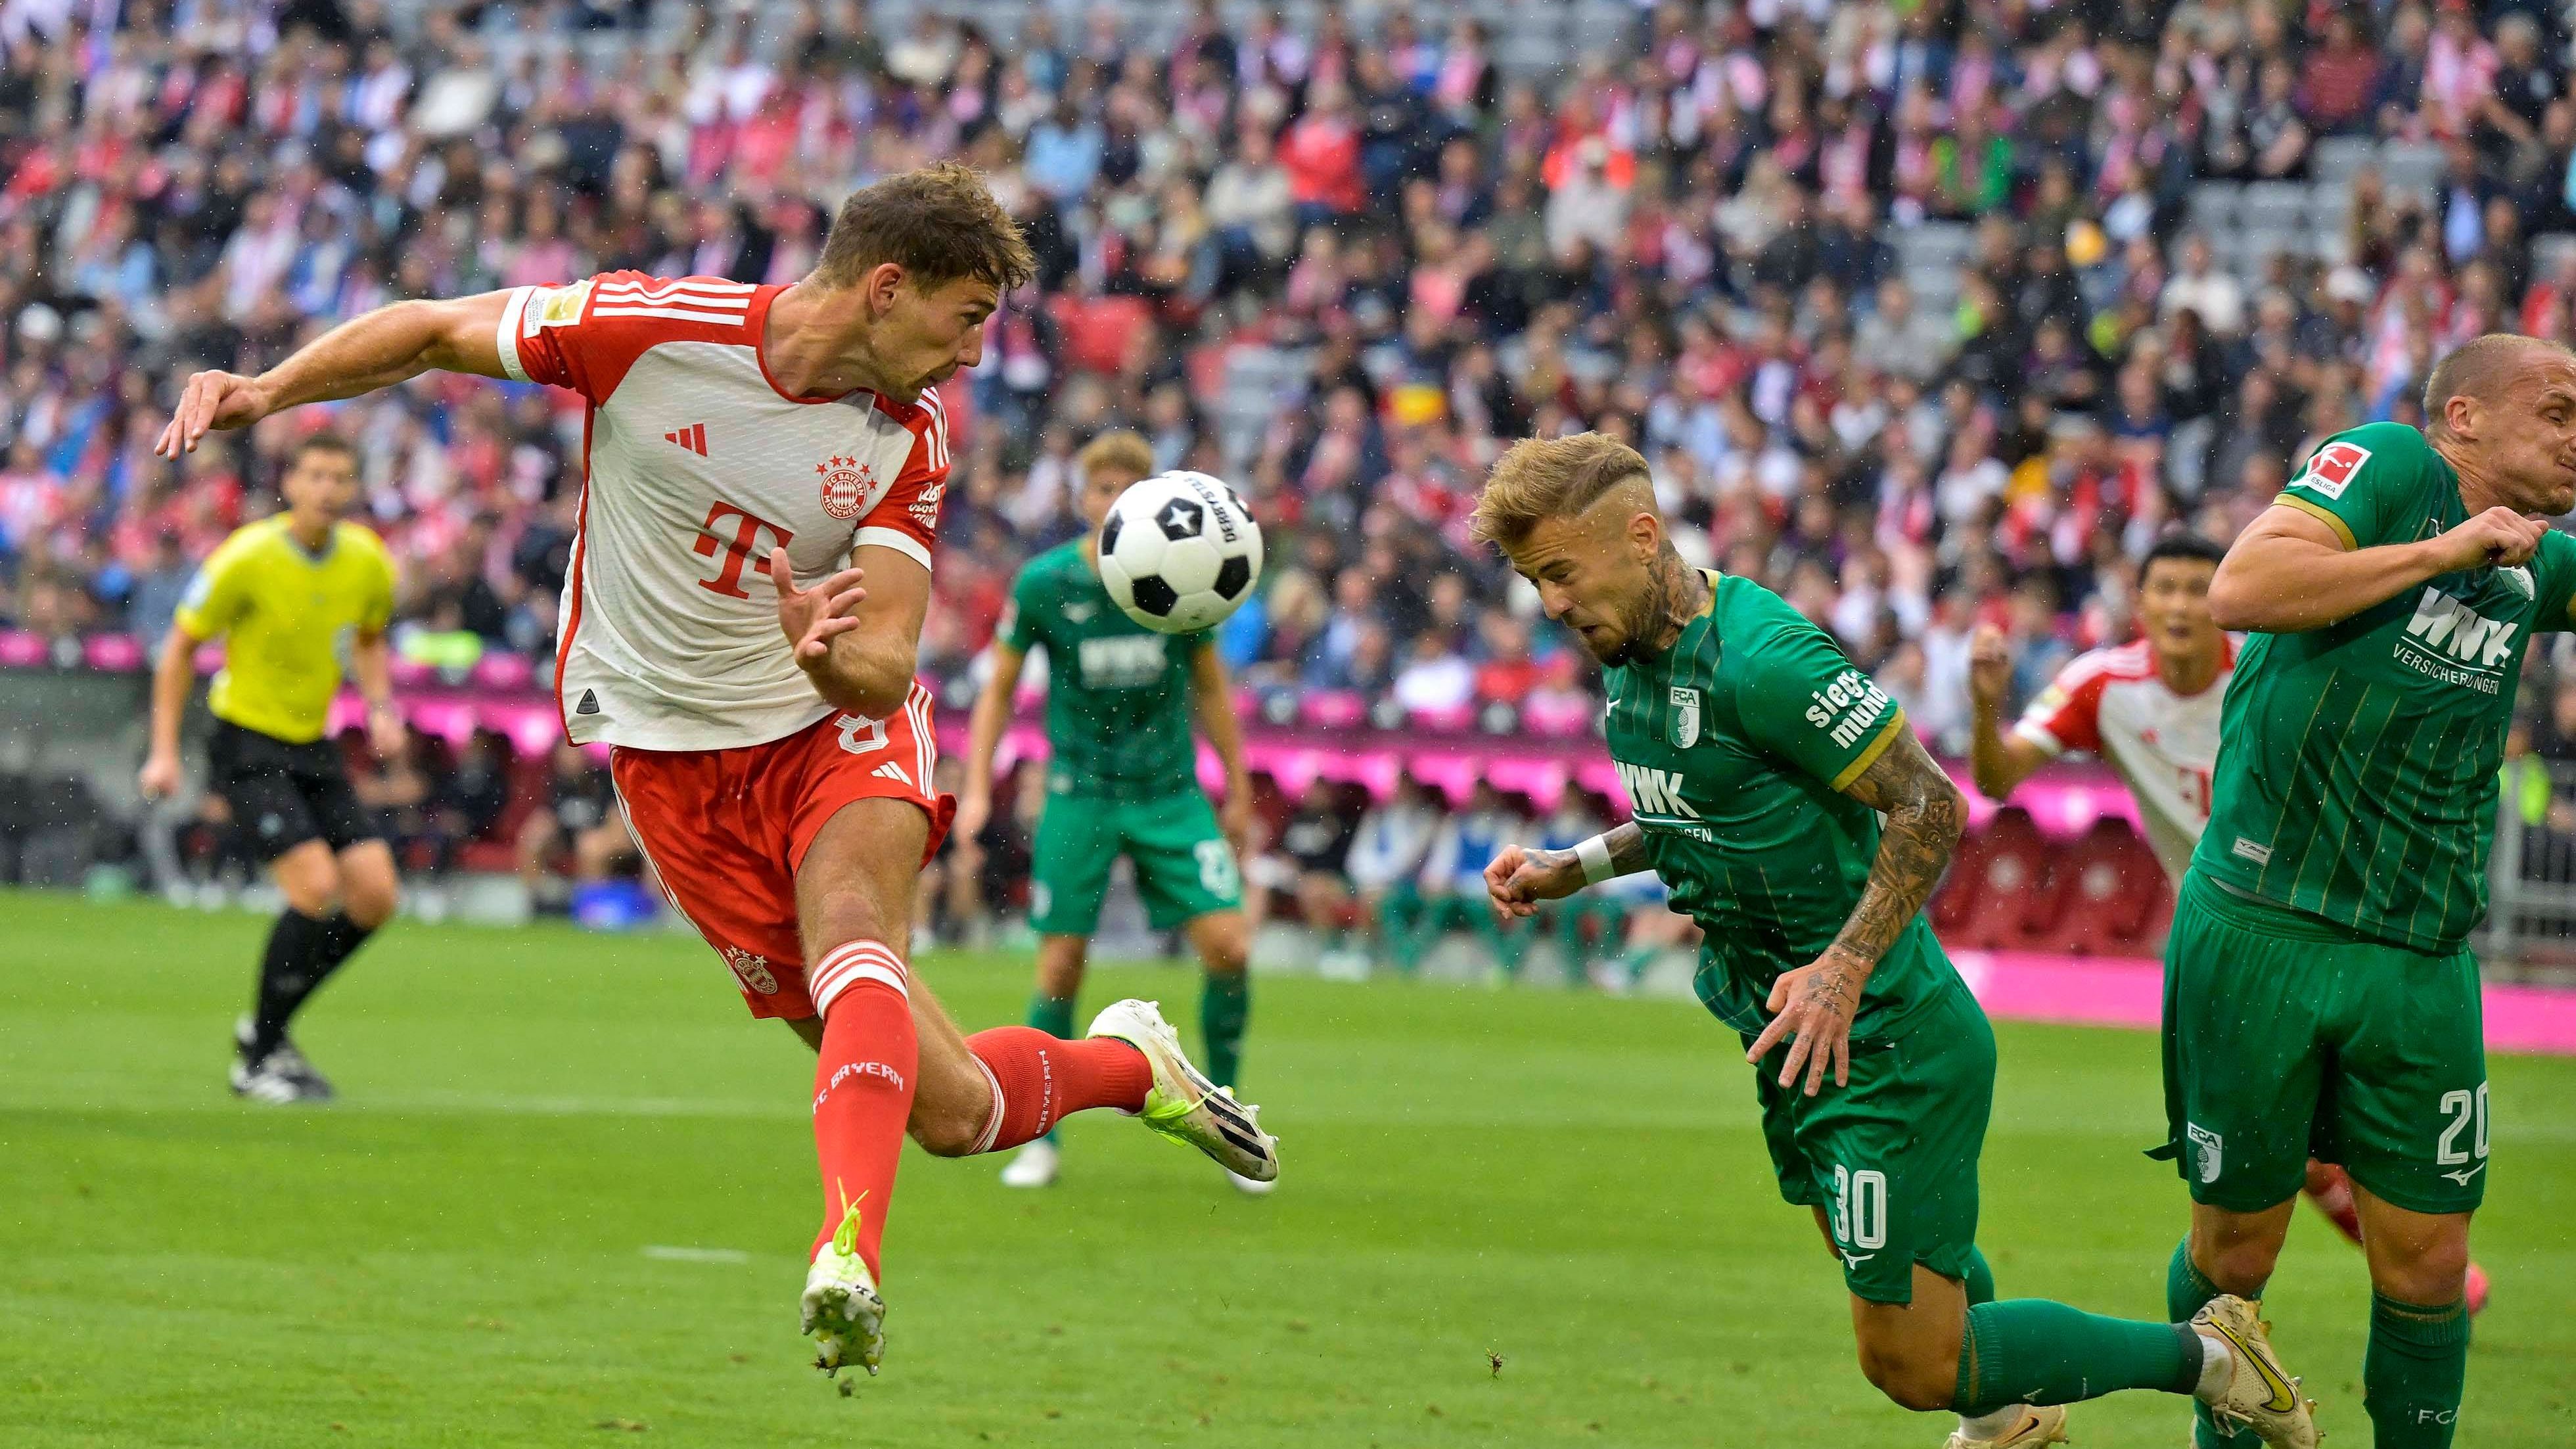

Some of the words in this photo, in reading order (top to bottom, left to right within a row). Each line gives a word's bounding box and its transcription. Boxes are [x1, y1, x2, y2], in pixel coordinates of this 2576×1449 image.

[827, 476, 837, 488] FC
[838, 473, 864, 496] BAYERN
[2311, 476, 2336, 493] ESLIGA
[693, 500, 794, 600] T
[2406, 585, 2519, 668] WWK
[1673, 689, 1697, 705] FCA
[2393, 643, 2499, 695] VERSICHERUNGEN
[1829, 679, 1889, 750] mund
[1613, 759, 1701, 819] WWK
[812, 1088, 828, 1115] FC
[830, 1061, 904, 1092] BAYERN
[2190, 1126, 2219, 1147] FCA
[2437, 1079, 2489, 1165] 20
[1834, 1163, 1887, 1249] 30
